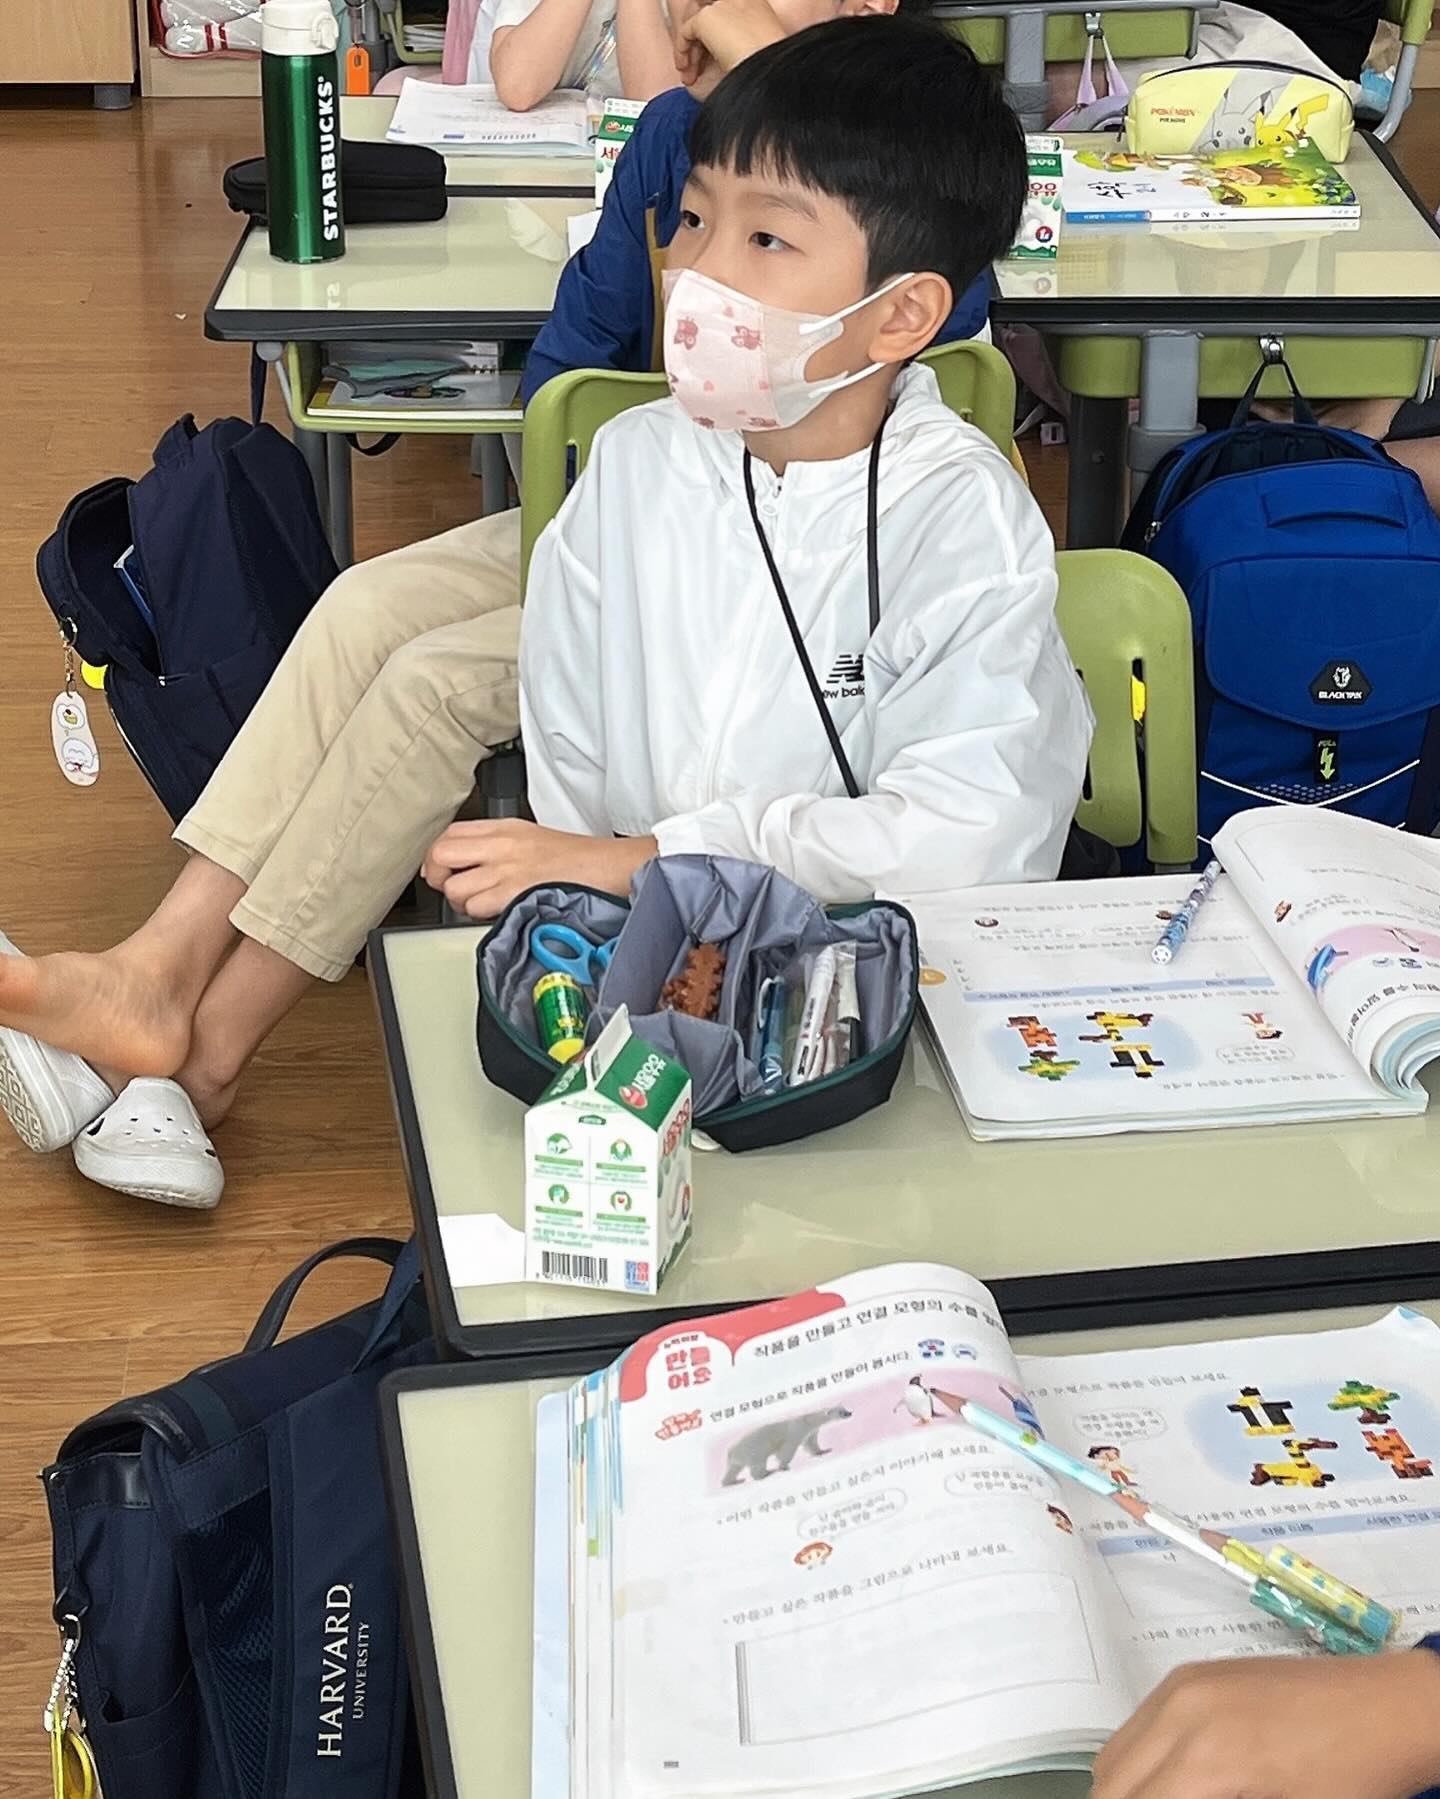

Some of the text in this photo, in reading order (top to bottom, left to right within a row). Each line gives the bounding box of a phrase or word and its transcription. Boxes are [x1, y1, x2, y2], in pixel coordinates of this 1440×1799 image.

[317, 80, 339, 241] STARBUCKS
[805, 1317, 852, 1343] 만들고
[856, 1306, 889, 1325] 연결
[894, 1300, 943, 1314] 모형의
[948, 1302, 979, 1319] 수를
[666, 1346, 711, 1371] 만들
[668, 1367, 712, 1389] 어요
[710, 1406, 735, 1423] 연결
[739, 1391, 788, 1412] 모형으로
[831, 1361, 869, 1383] 만들어
[316, 1584, 352, 1757] HARVARD
[352, 1621, 371, 1719] UNIVERSITY
